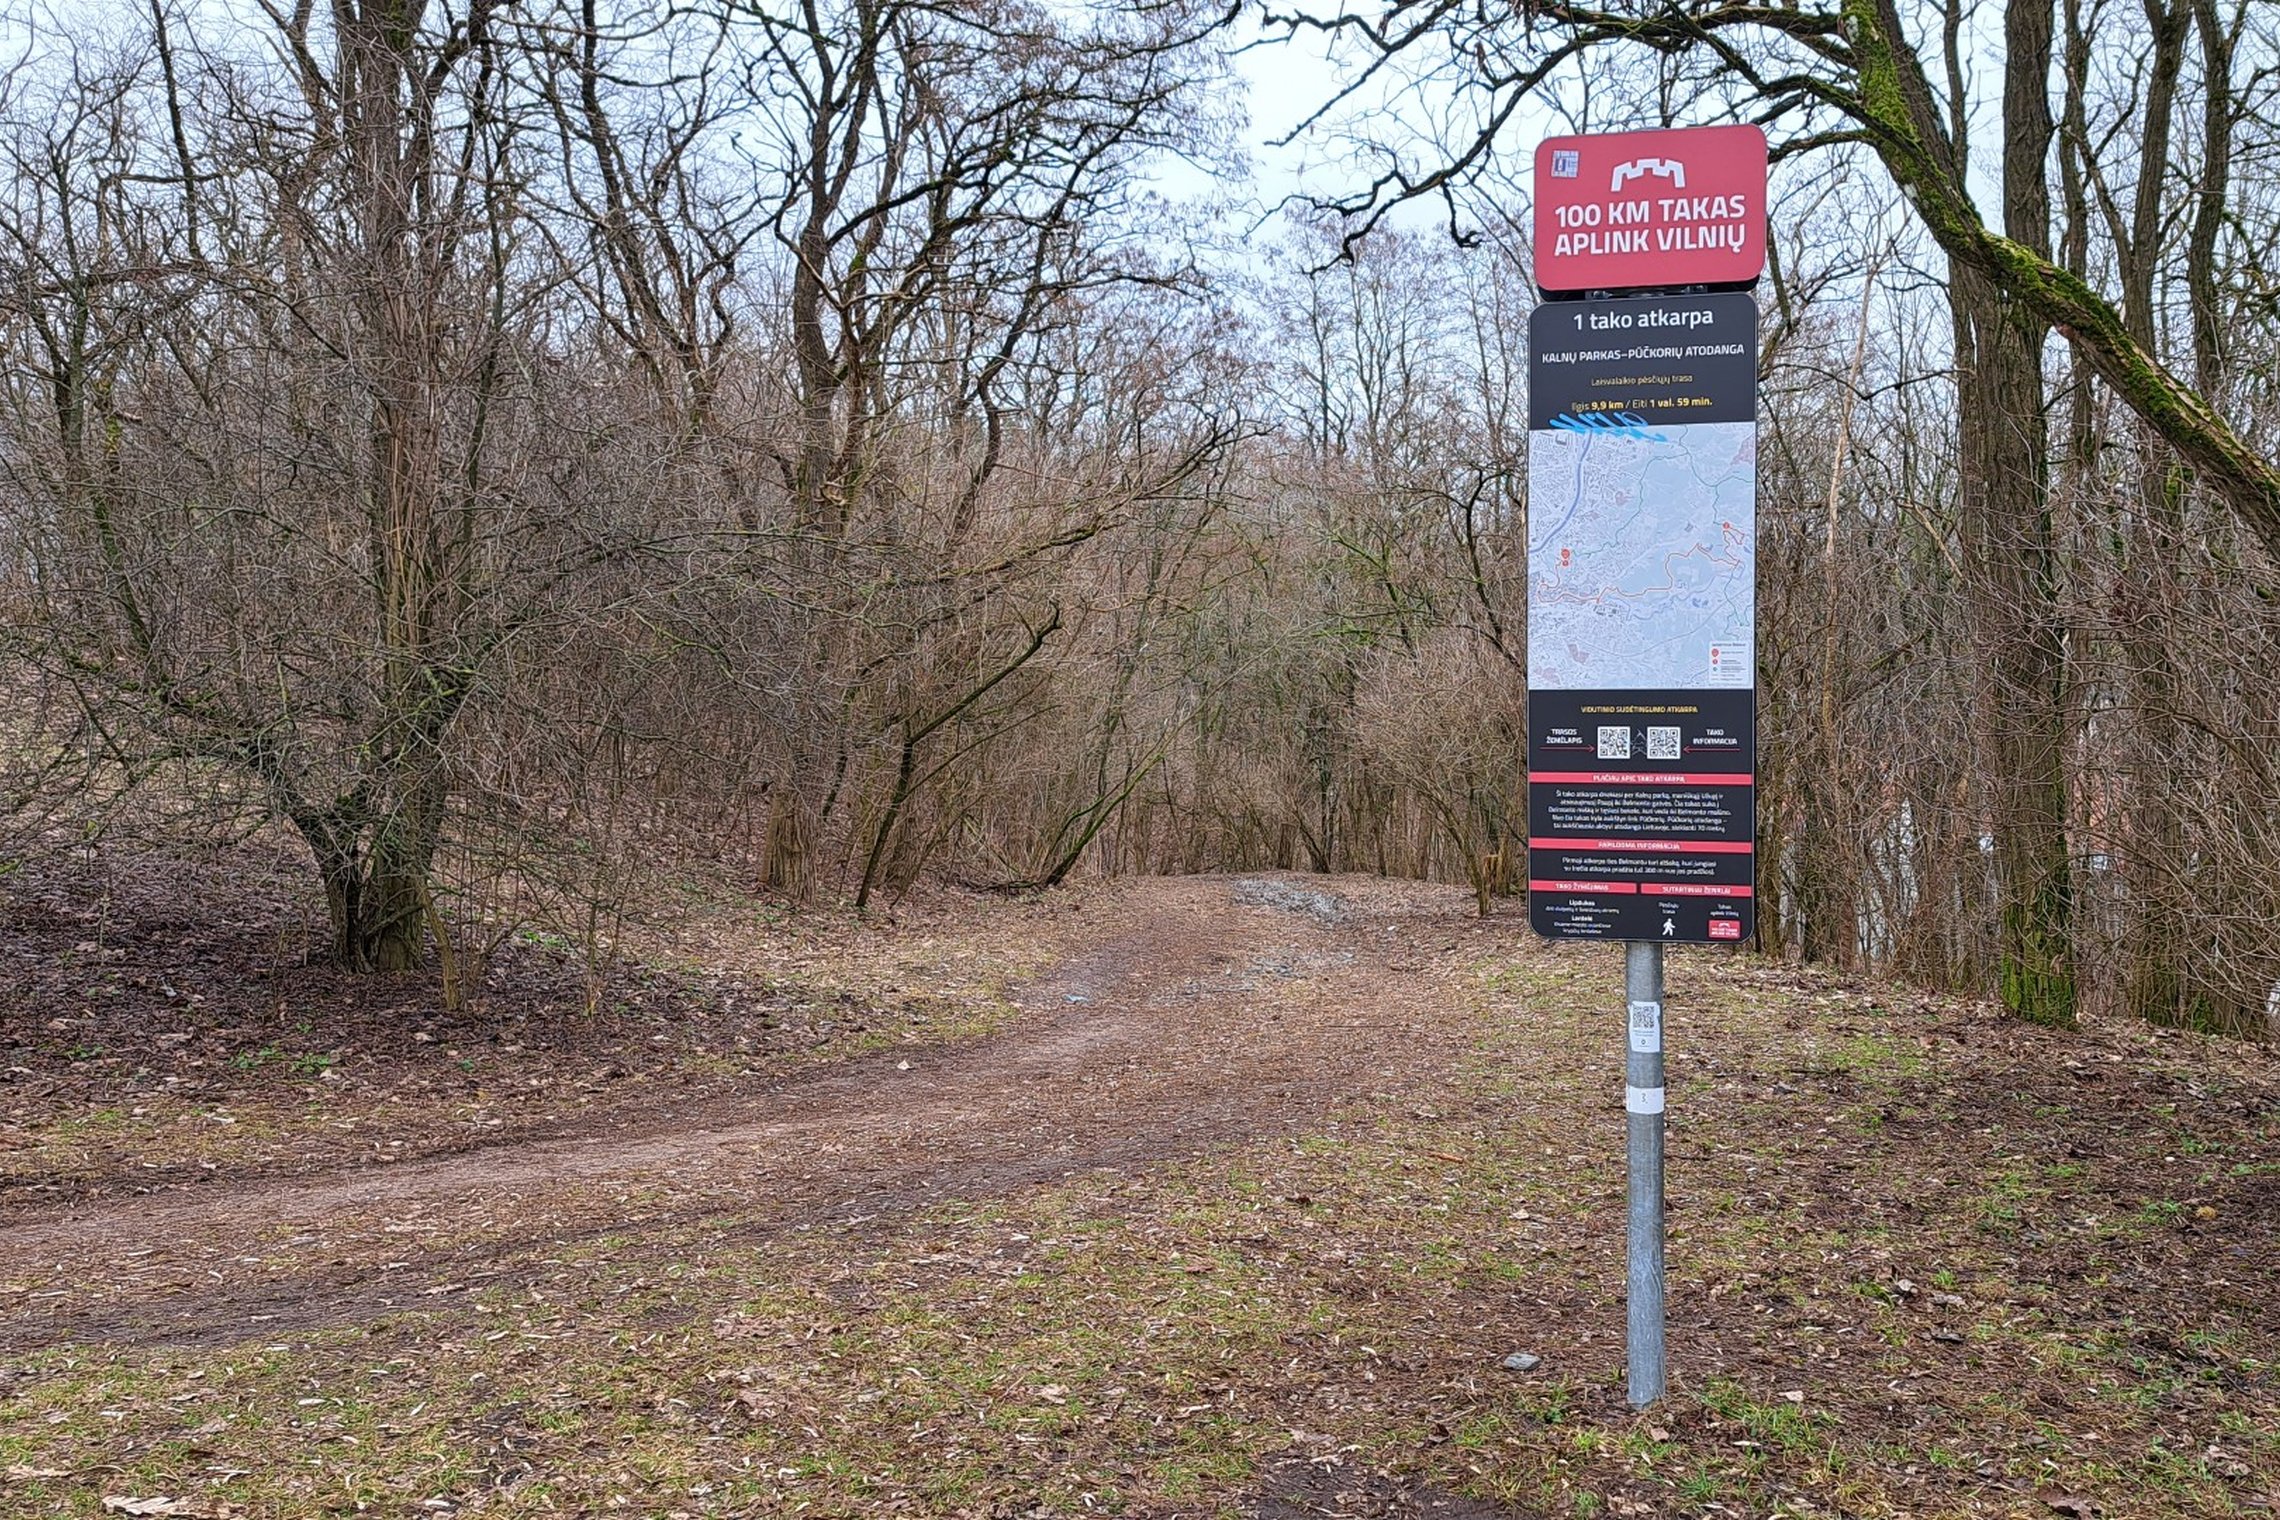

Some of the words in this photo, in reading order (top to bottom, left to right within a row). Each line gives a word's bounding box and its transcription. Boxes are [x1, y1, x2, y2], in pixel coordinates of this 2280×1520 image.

[1555, 204, 1601, 228] 100
[1608, 201, 1649, 225] KM
[1658, 195, 1745, 222] TAKAS
[1554, 229, 1650, 256] APLINK
[1656, 224, 1745, 253] VILNIŲ
[1573, 314, 1582, 330] 1
[1589, 311, 1633, 330] tako
[1638, 309, 1714, 329] atkarpa
[1542, 352, 1577, 364] KALNŲ
[1685, 344, 1744, 357] ATODANGA
[1672, 374, 1693, 383] trasa
[1571, 402, 1590, 413] Ilgis
[1591, 401, 1607, 411] 9,9
[1608, 400, 1624, 409] km
[1625, 400, 1630, 409] /
[1632, 399, 1648, 408] Eiti
[1650, 399, 1655, 408] 1
[1658, 398, 1674, 407] val.
[1677, 397, 1690, 407] 59
[1691, 396, 1713, 406] min.
[1706, 728, 1724, 736] TAKO
